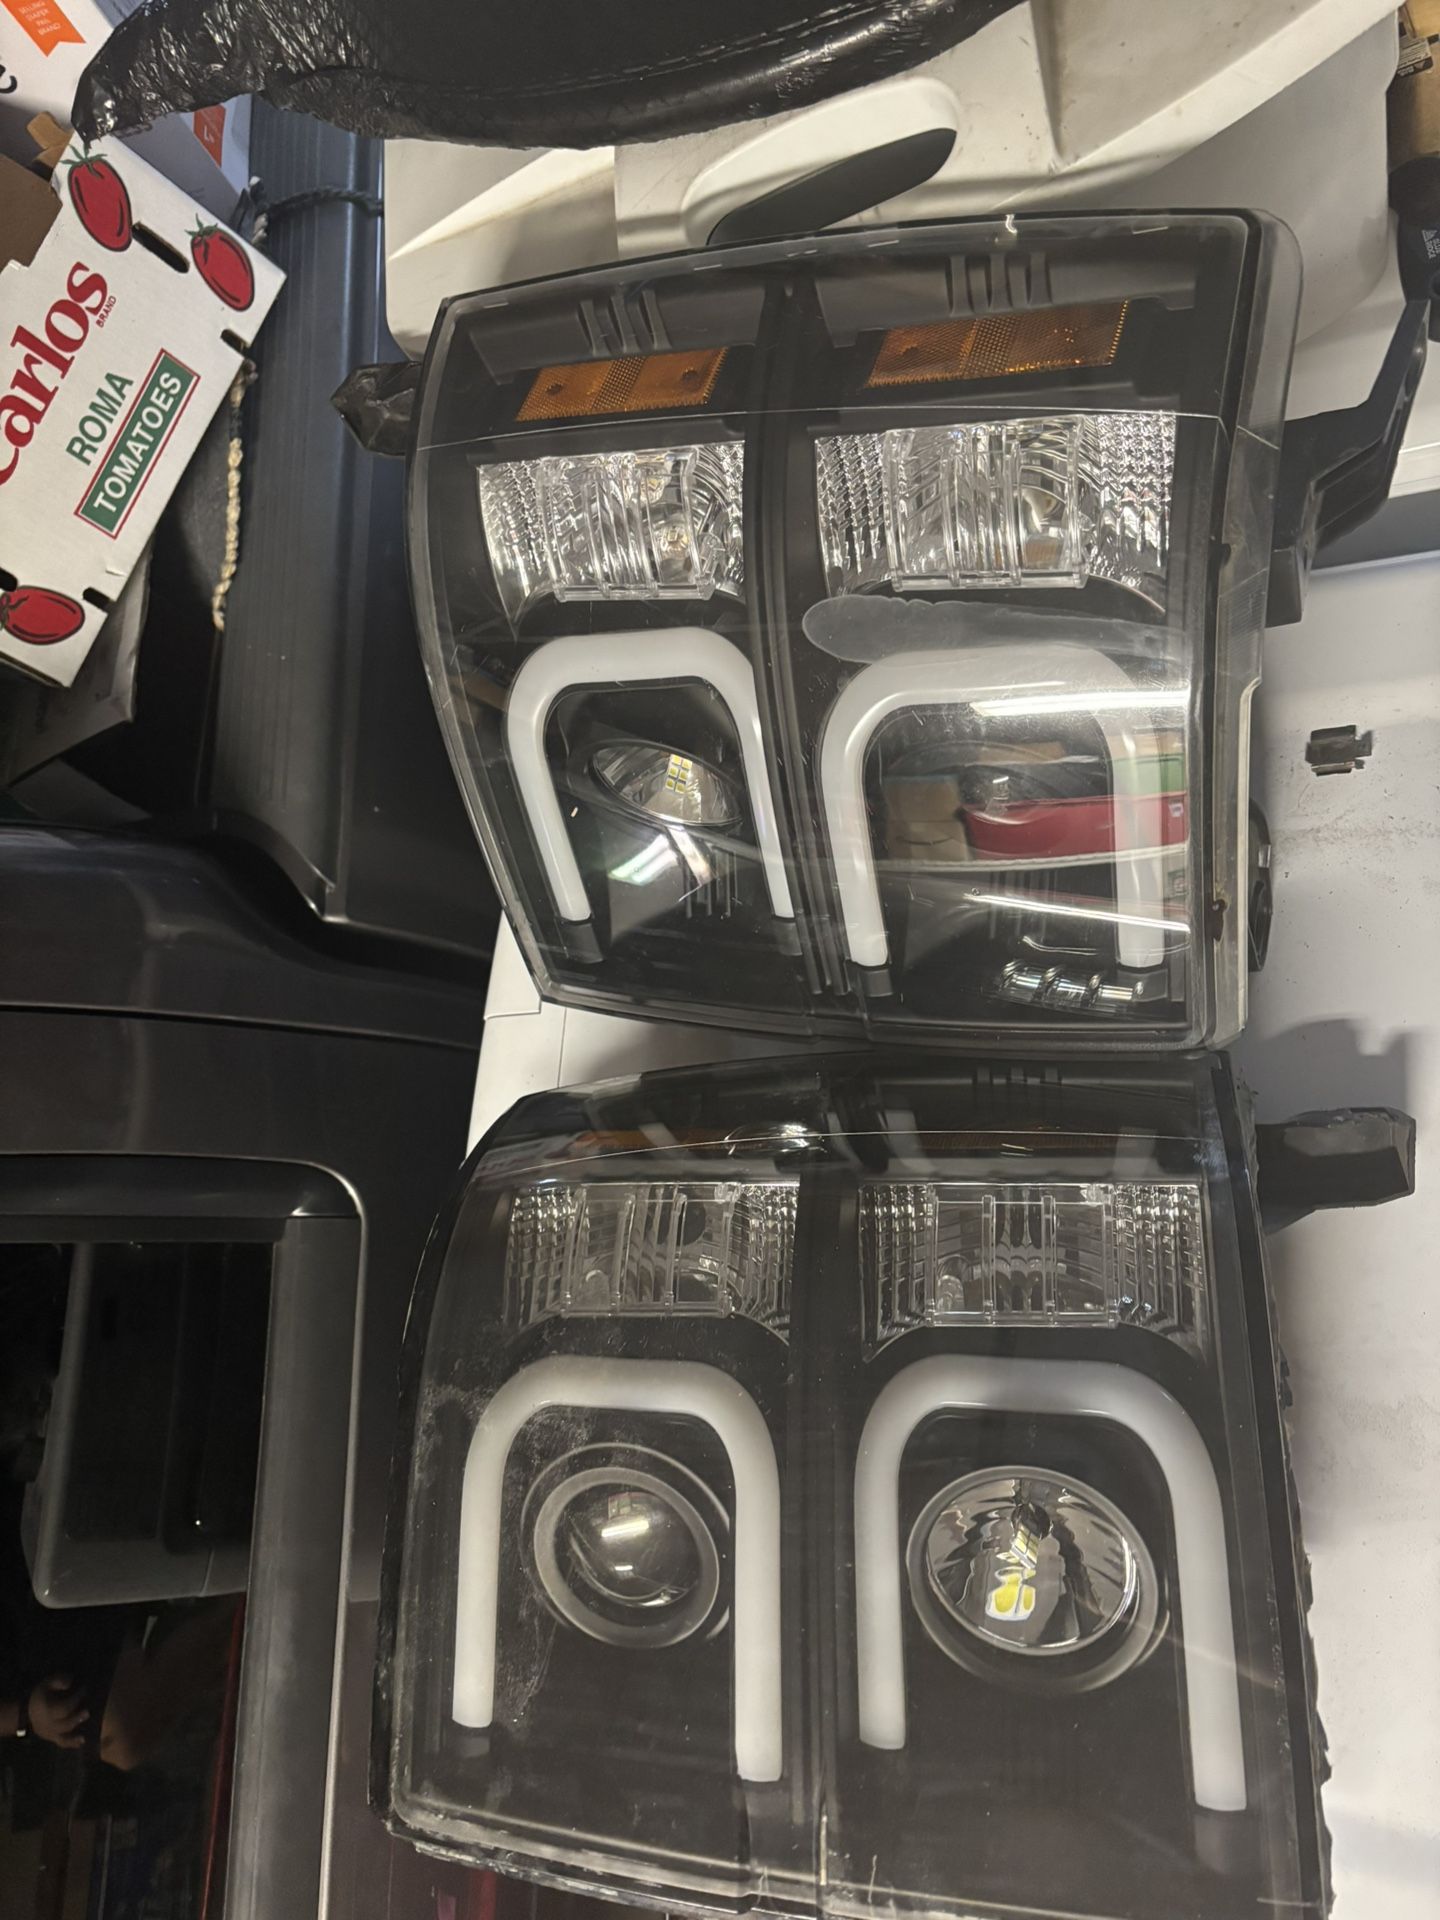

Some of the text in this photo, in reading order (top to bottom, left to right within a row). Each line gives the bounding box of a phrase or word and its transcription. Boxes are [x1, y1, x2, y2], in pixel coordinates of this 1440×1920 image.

[96, 295, 116, 328] BRAND
[65, 372, 134, 466] ROMA
[93, 371, 182, 513] TOMATOES
